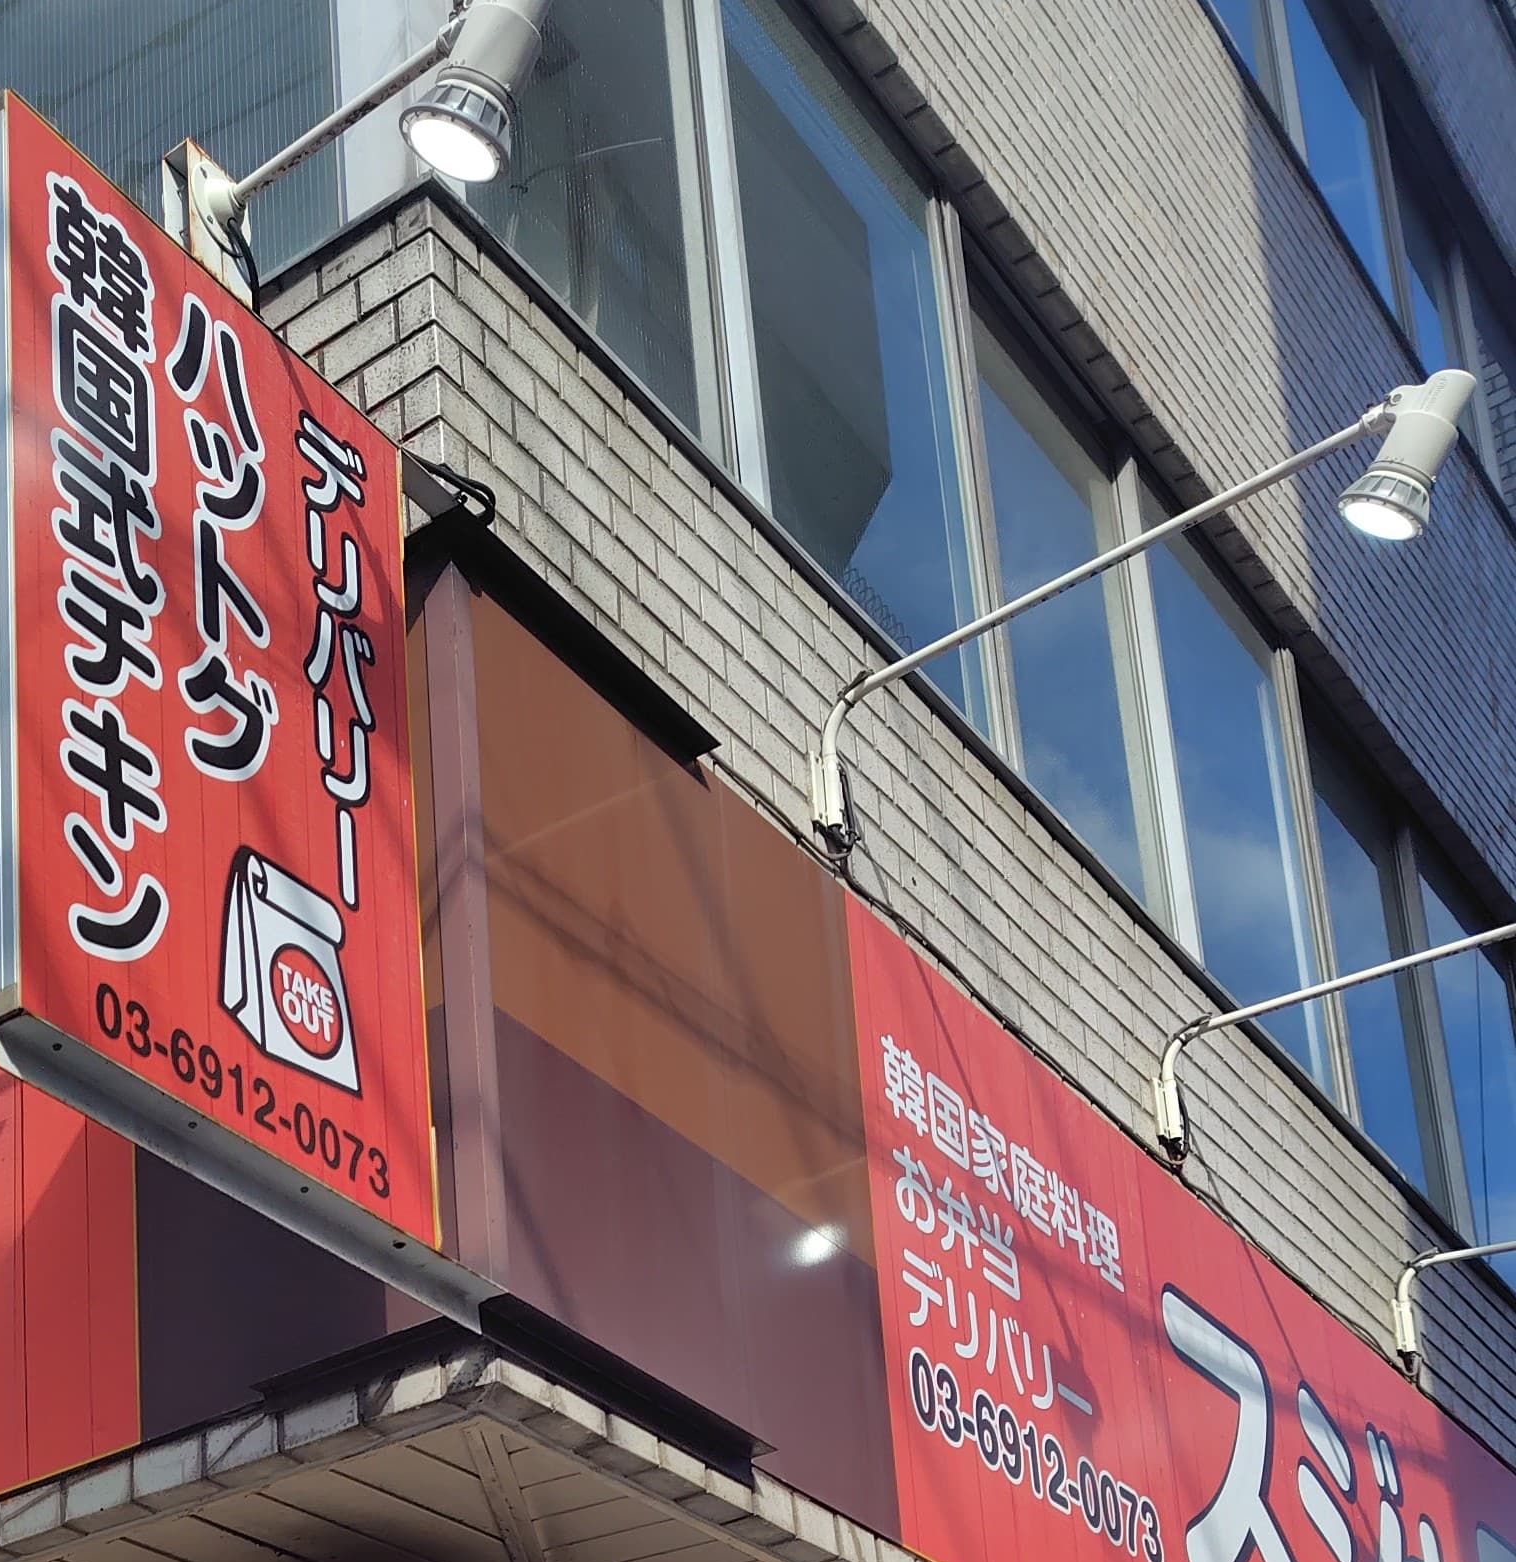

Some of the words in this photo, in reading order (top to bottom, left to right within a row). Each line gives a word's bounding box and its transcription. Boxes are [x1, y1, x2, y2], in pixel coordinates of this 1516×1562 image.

[46, 172, 169, 961] 韓国式チキン
[165, 292, 279, 780] ハットグ
[295, 410, 376, 910] デリバリー
[96, 984, 390, 1199] 03-6912-0073
[277, 961, 332, 1014] TAKE
[282, 995, 334, 1042] OUT
[882, 1035, 1125, 1294] 韓国家庭料理
[893, 1147, 1020, 1302] お弁当
[902, 1249, 1093, 1416] デリバリー
